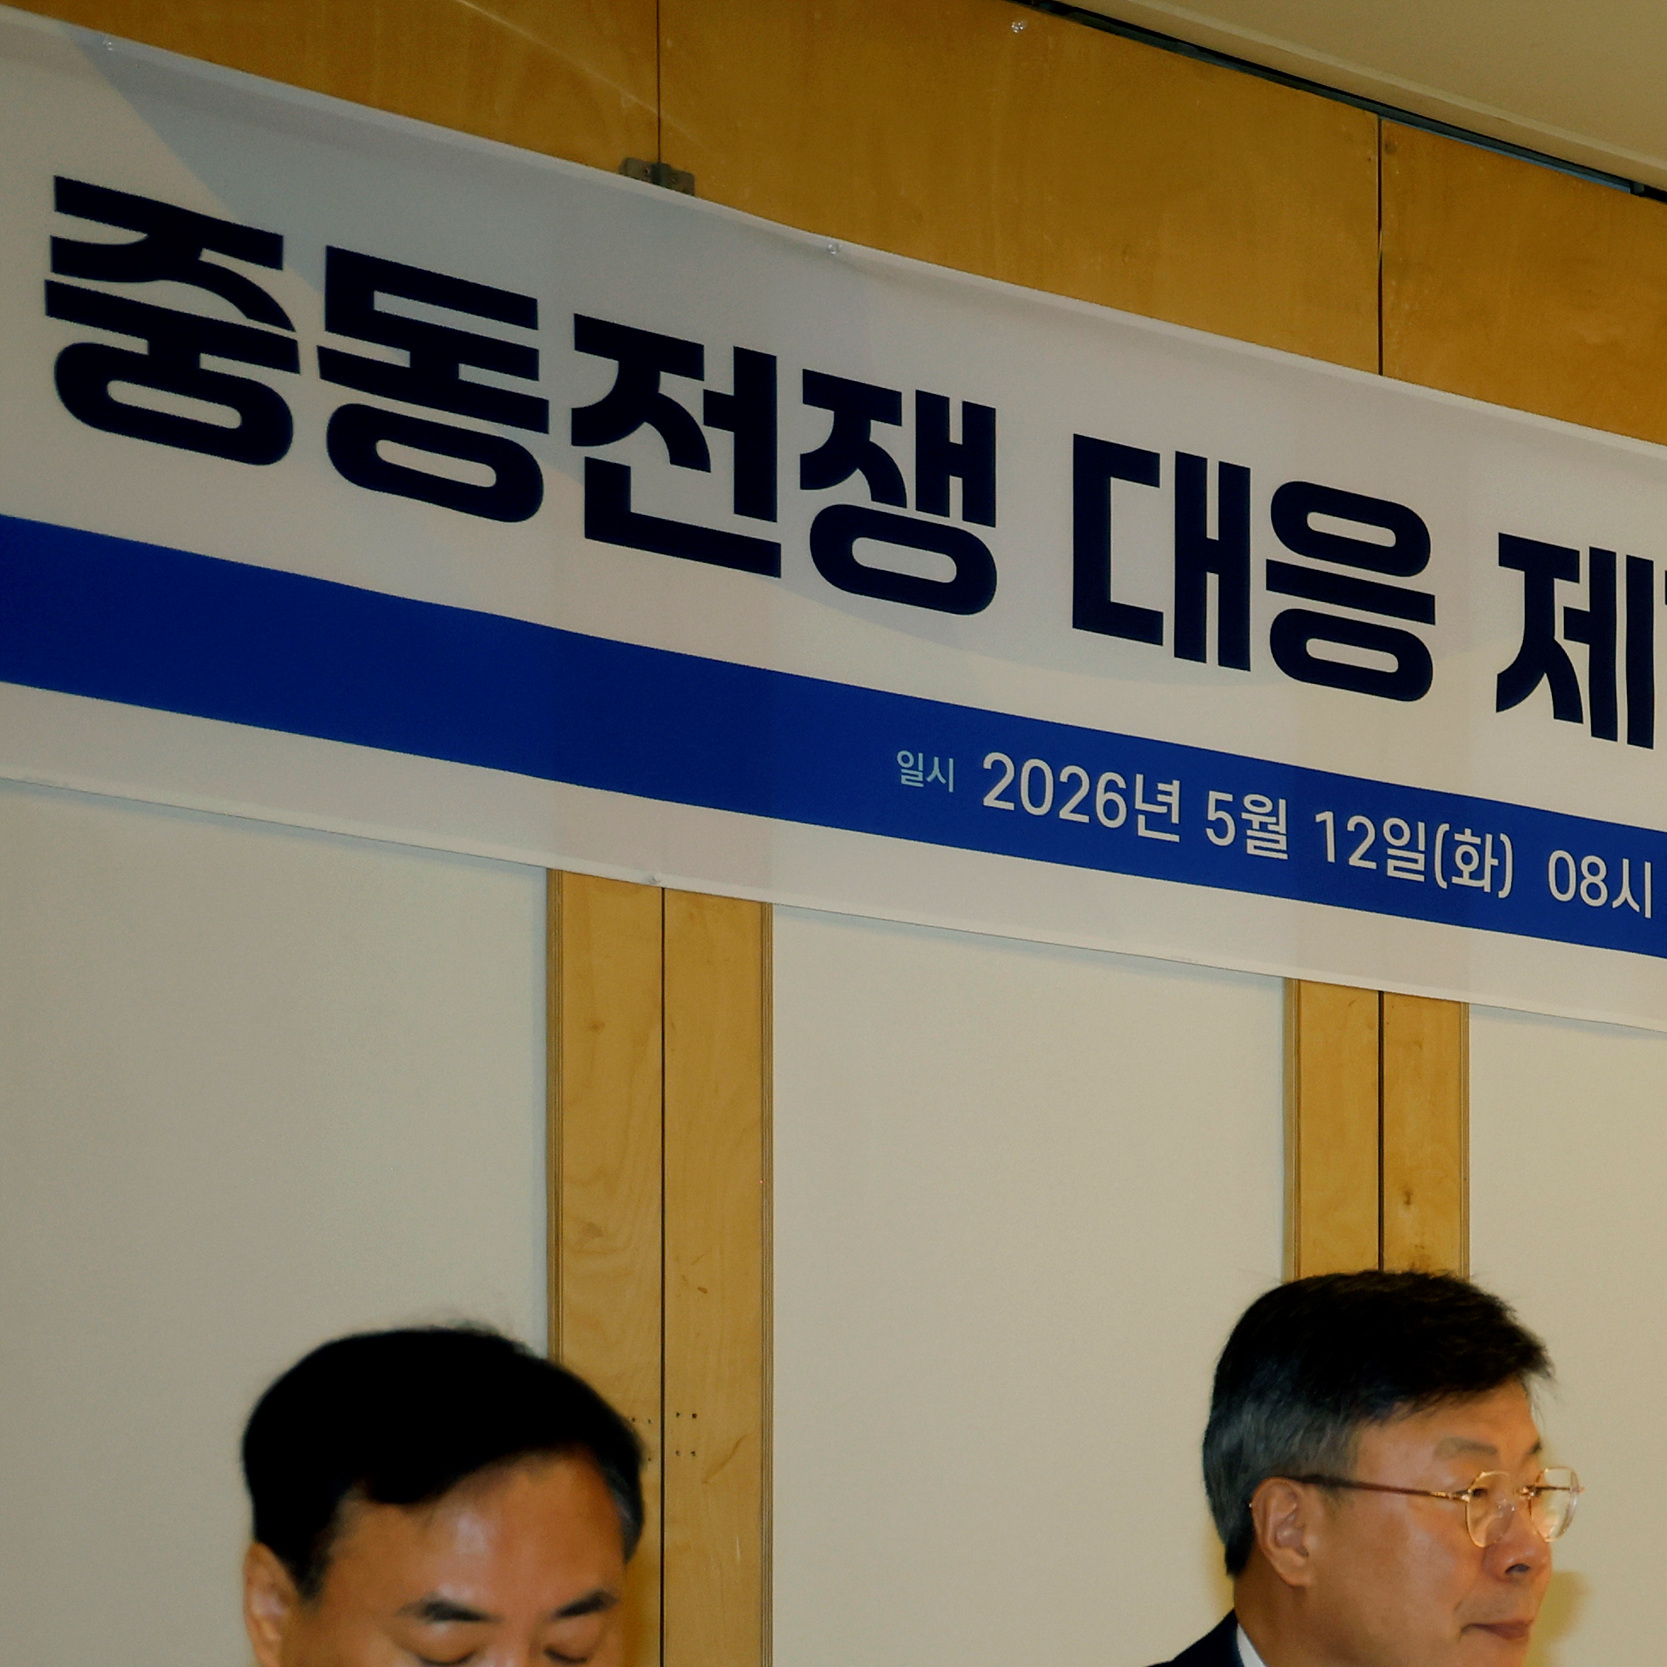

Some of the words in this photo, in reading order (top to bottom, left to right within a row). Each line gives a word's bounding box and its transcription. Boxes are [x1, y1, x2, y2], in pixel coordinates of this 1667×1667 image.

[44, 175, 998, 616] 중동전쟁
[1072, 433, 1436, 702] 대응
[897, 750, 954, 793] 일시
[983, 752, 1180, 843] 2026년
[1205, 790, 1289, 860] 5월
[1315, 810, 1513, 899] 12일(화)
[1548, 849, 1652, 919] 08시
